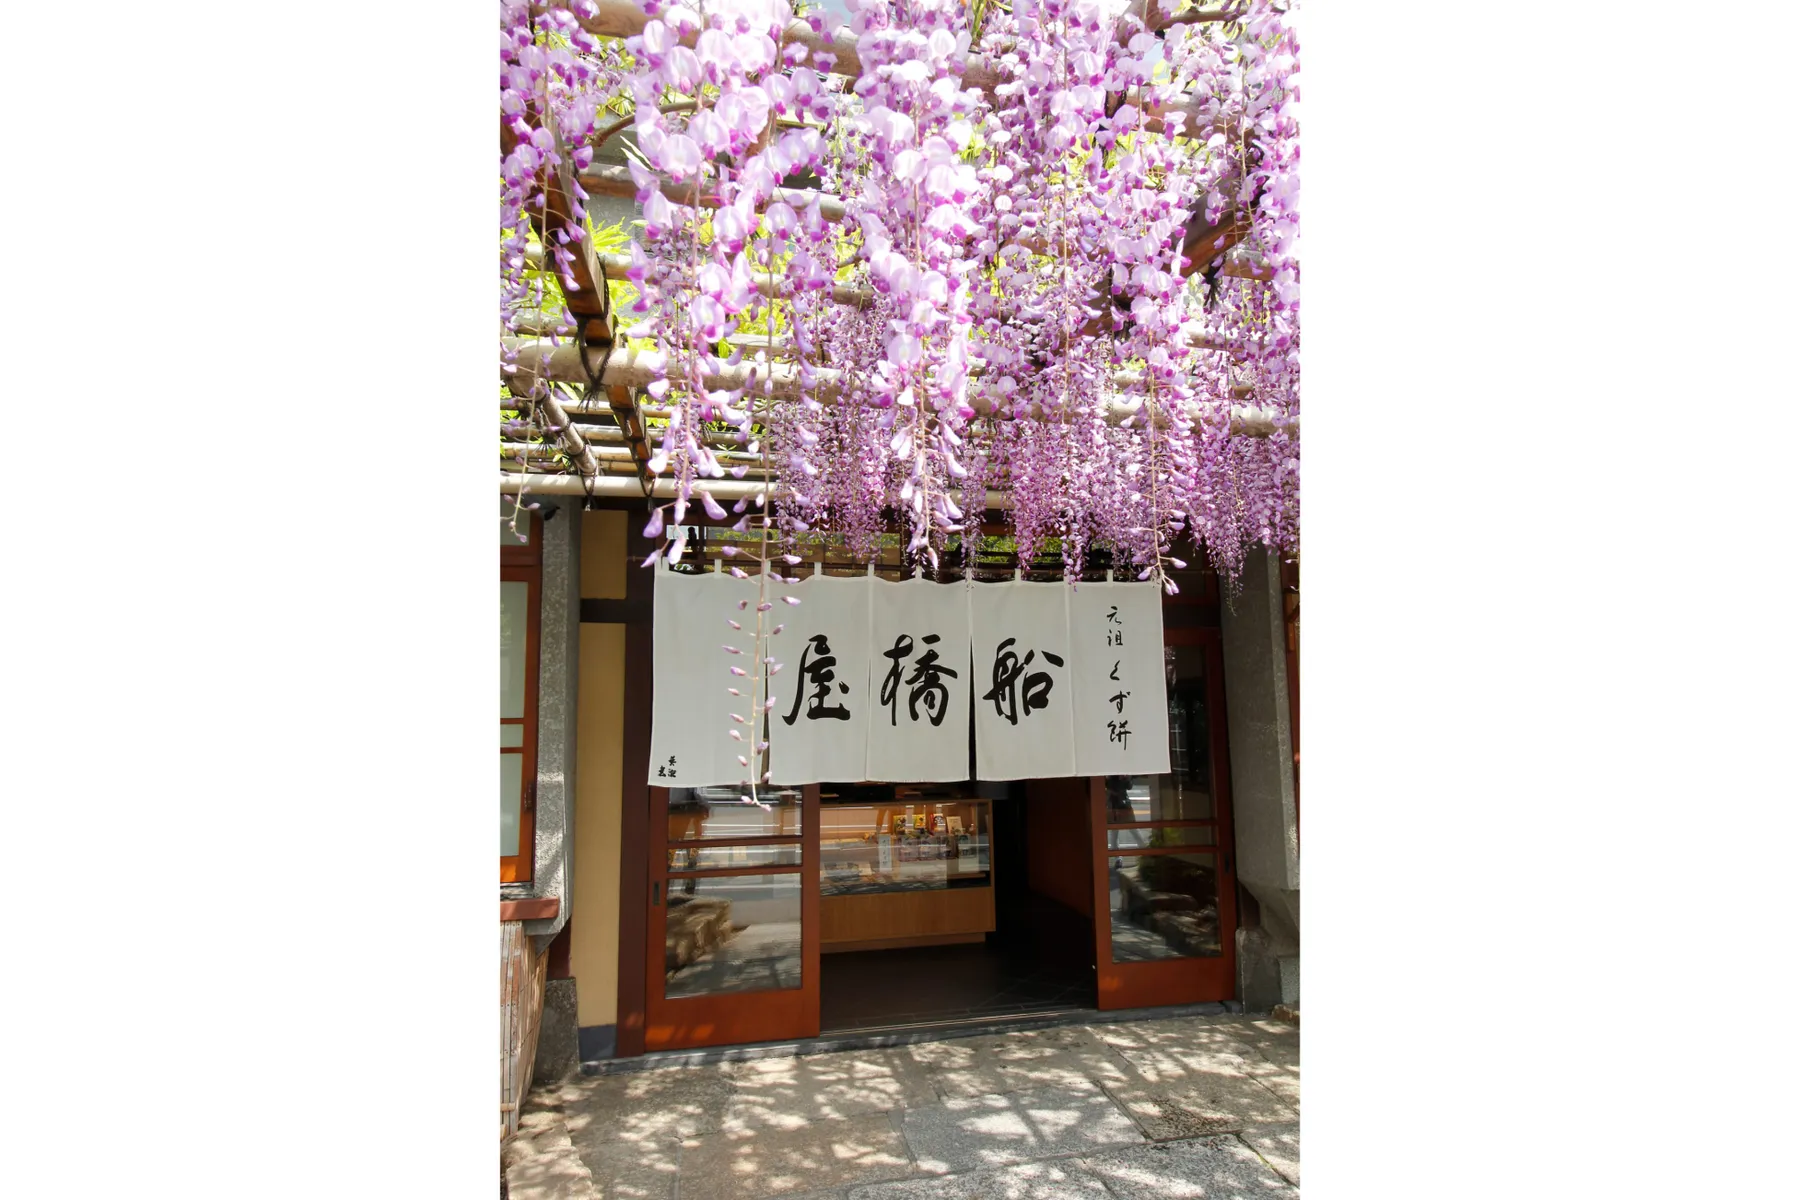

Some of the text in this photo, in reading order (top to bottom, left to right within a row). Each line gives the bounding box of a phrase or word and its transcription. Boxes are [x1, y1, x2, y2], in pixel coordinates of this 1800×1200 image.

[1106, 605, 1132, 751] 元祖くず餅
